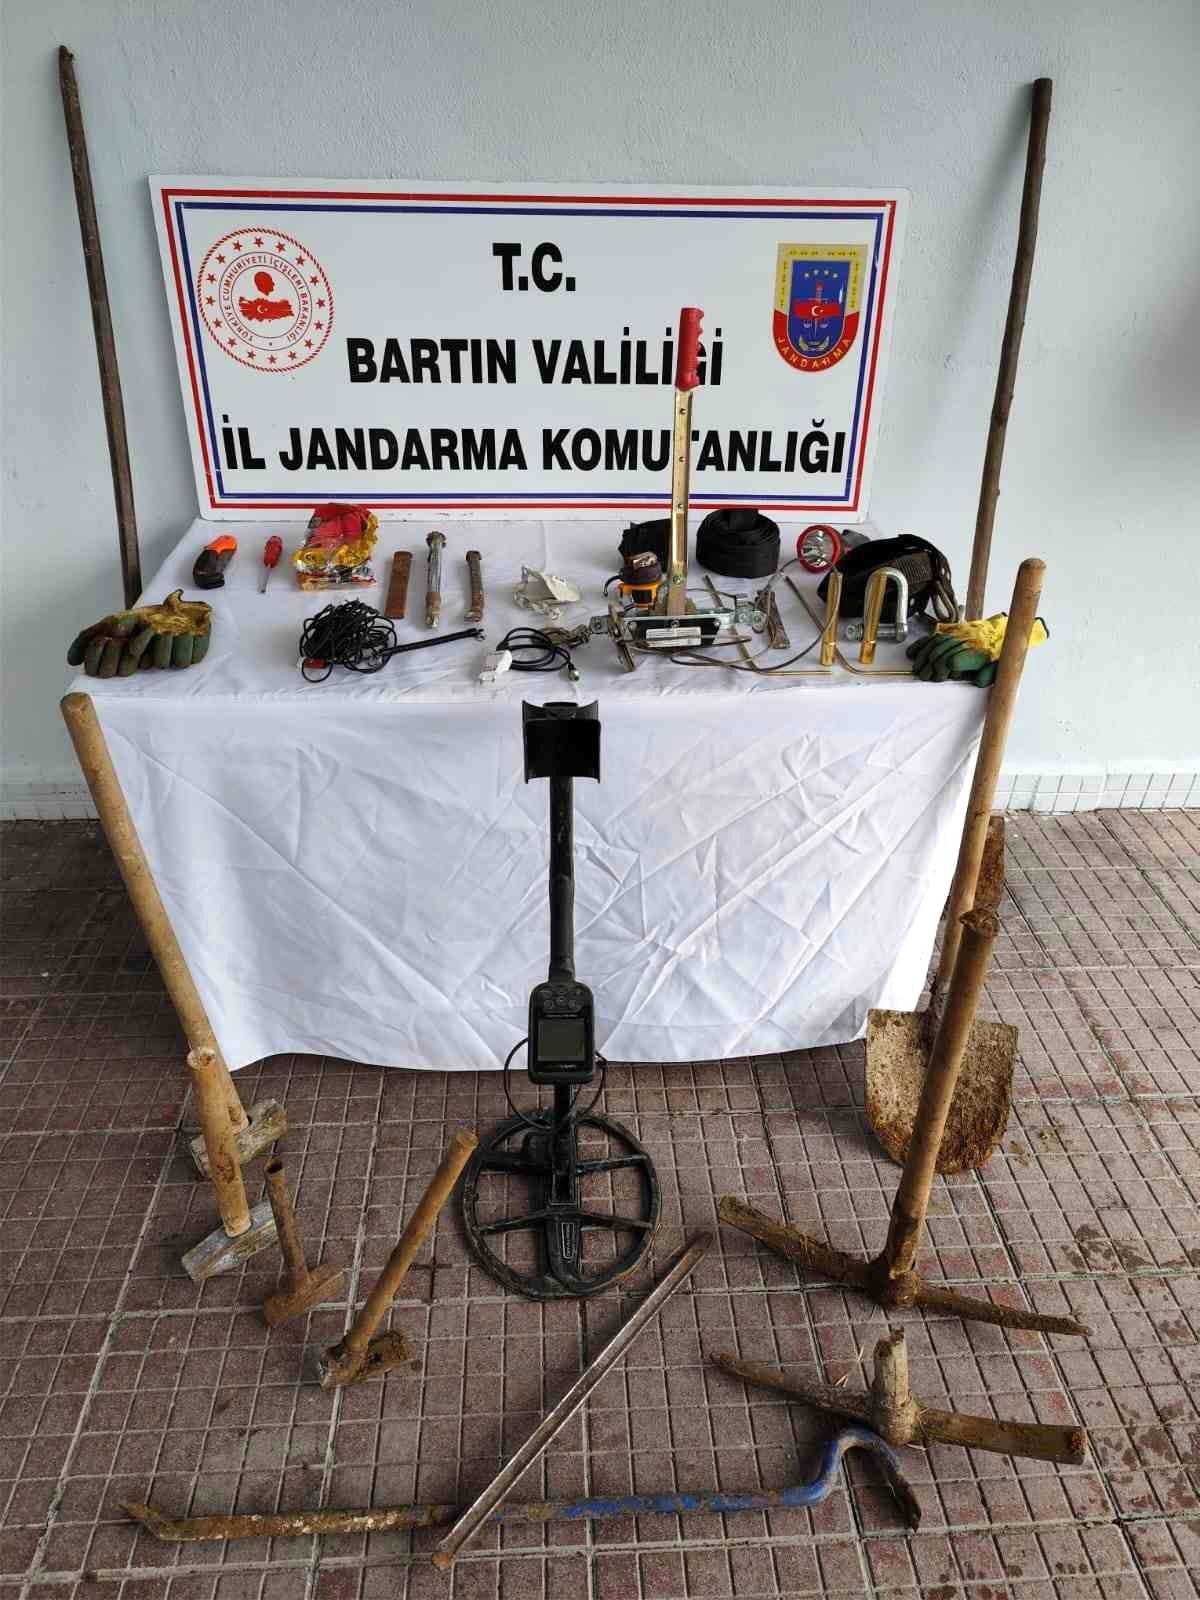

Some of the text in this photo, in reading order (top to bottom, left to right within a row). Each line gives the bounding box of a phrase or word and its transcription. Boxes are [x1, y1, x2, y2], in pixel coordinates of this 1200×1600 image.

[492, 241, 576, 292] T.C.
[346, 337, 517, 384] BARTIN
[778, 337, 851, 368] JANDARMA
[221, 414, 266, 470] İL
[278, 427, 528, 471] JANDARMA
